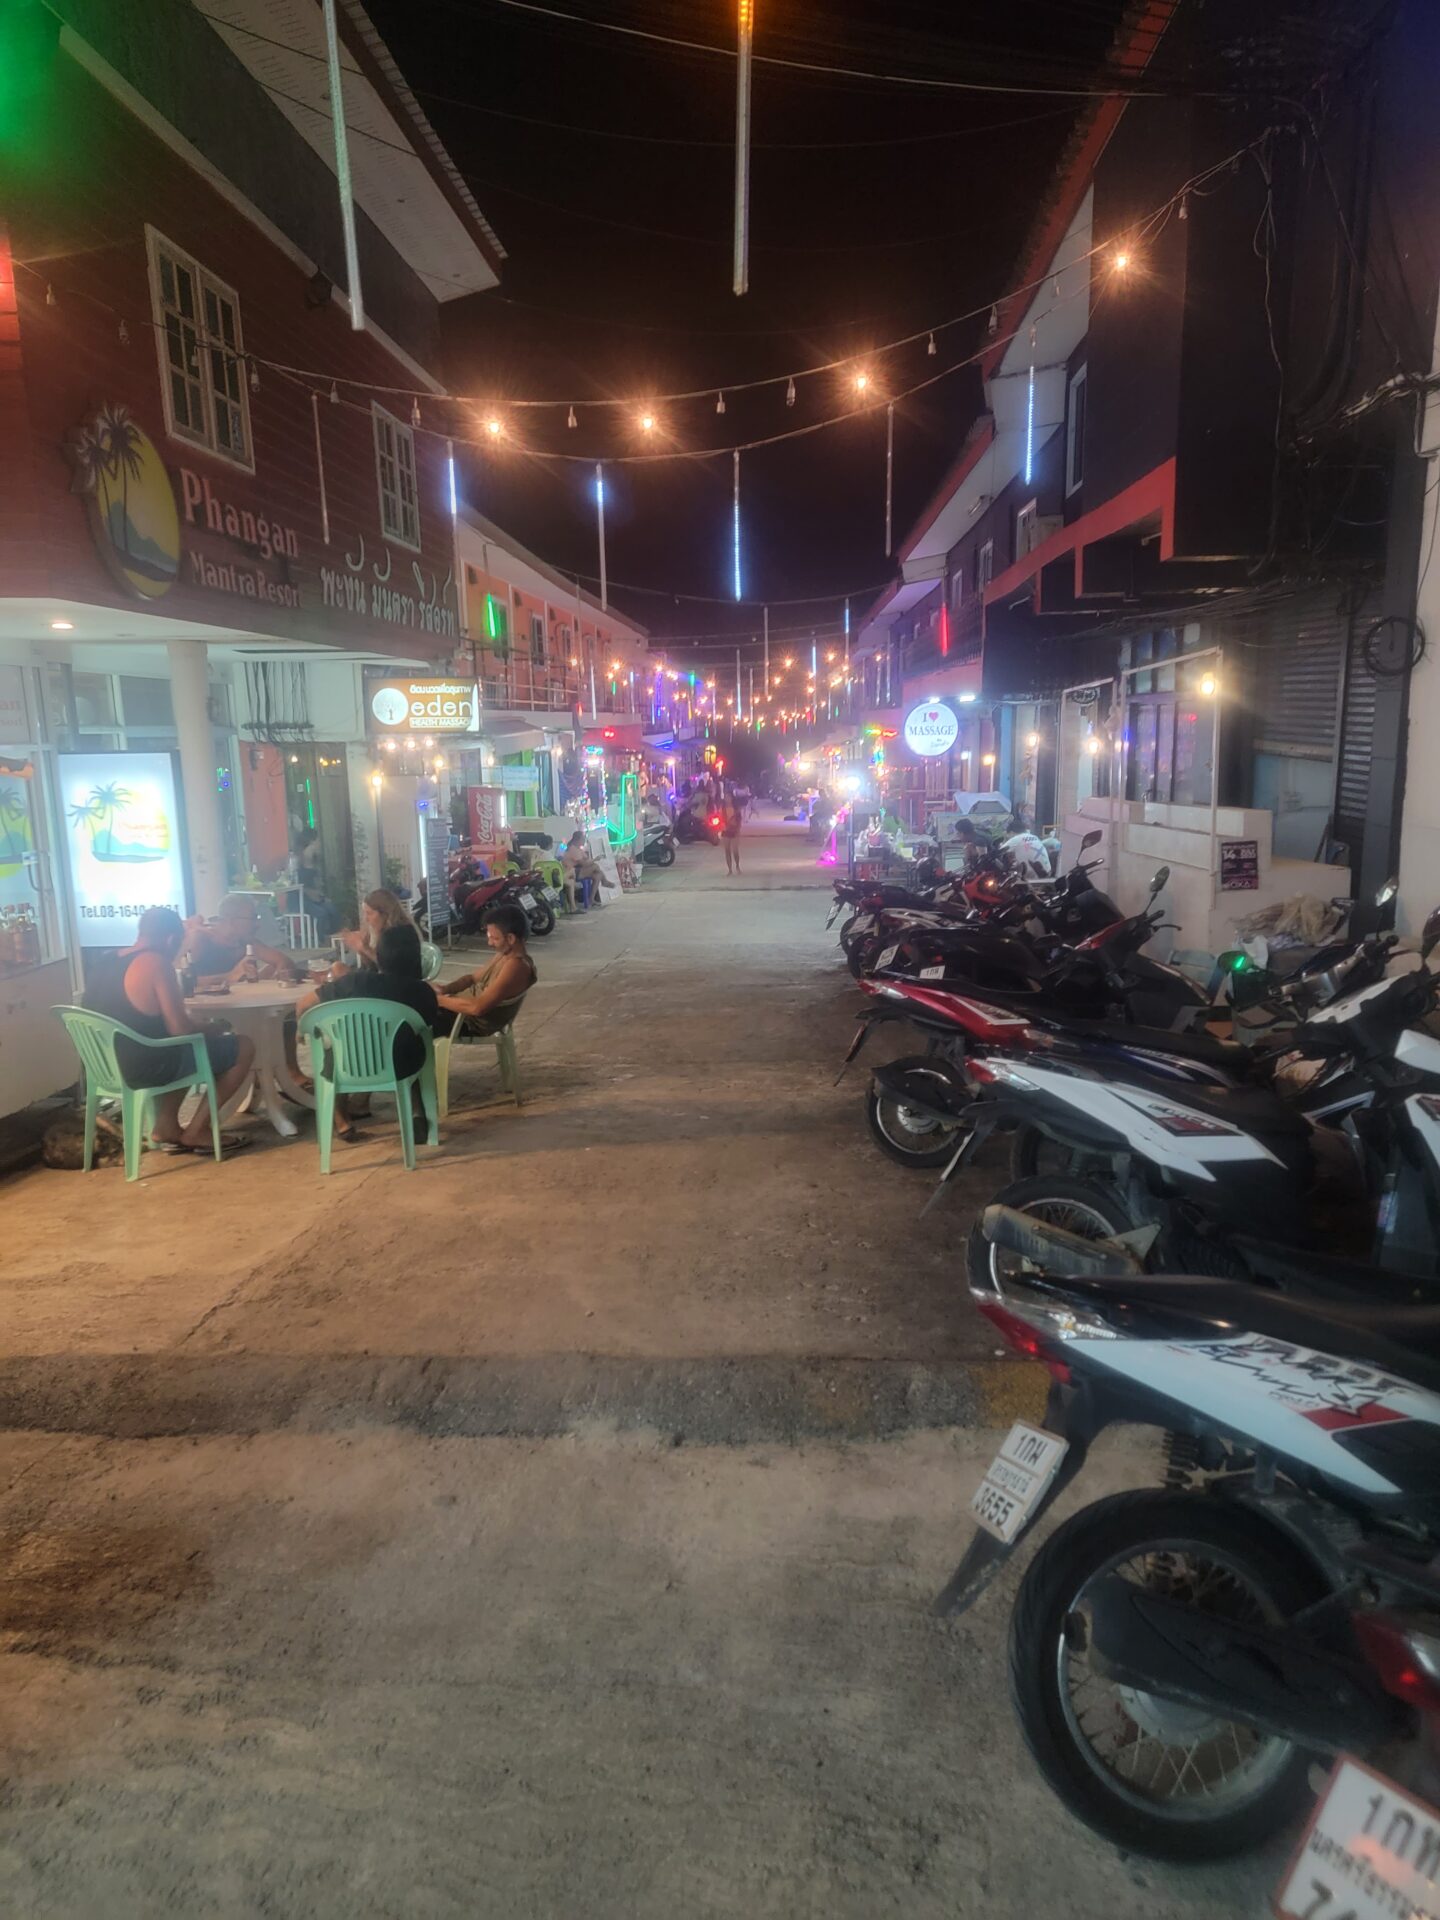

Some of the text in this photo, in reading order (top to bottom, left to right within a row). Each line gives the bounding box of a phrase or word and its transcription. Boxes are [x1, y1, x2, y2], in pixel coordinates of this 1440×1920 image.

[180, 468, 299, 560] Phangan
[410, 695, 474, 716] eden
[909, 725, 955, 736] MASSAGE
[975, 1487, 1015, 1527] 3655
